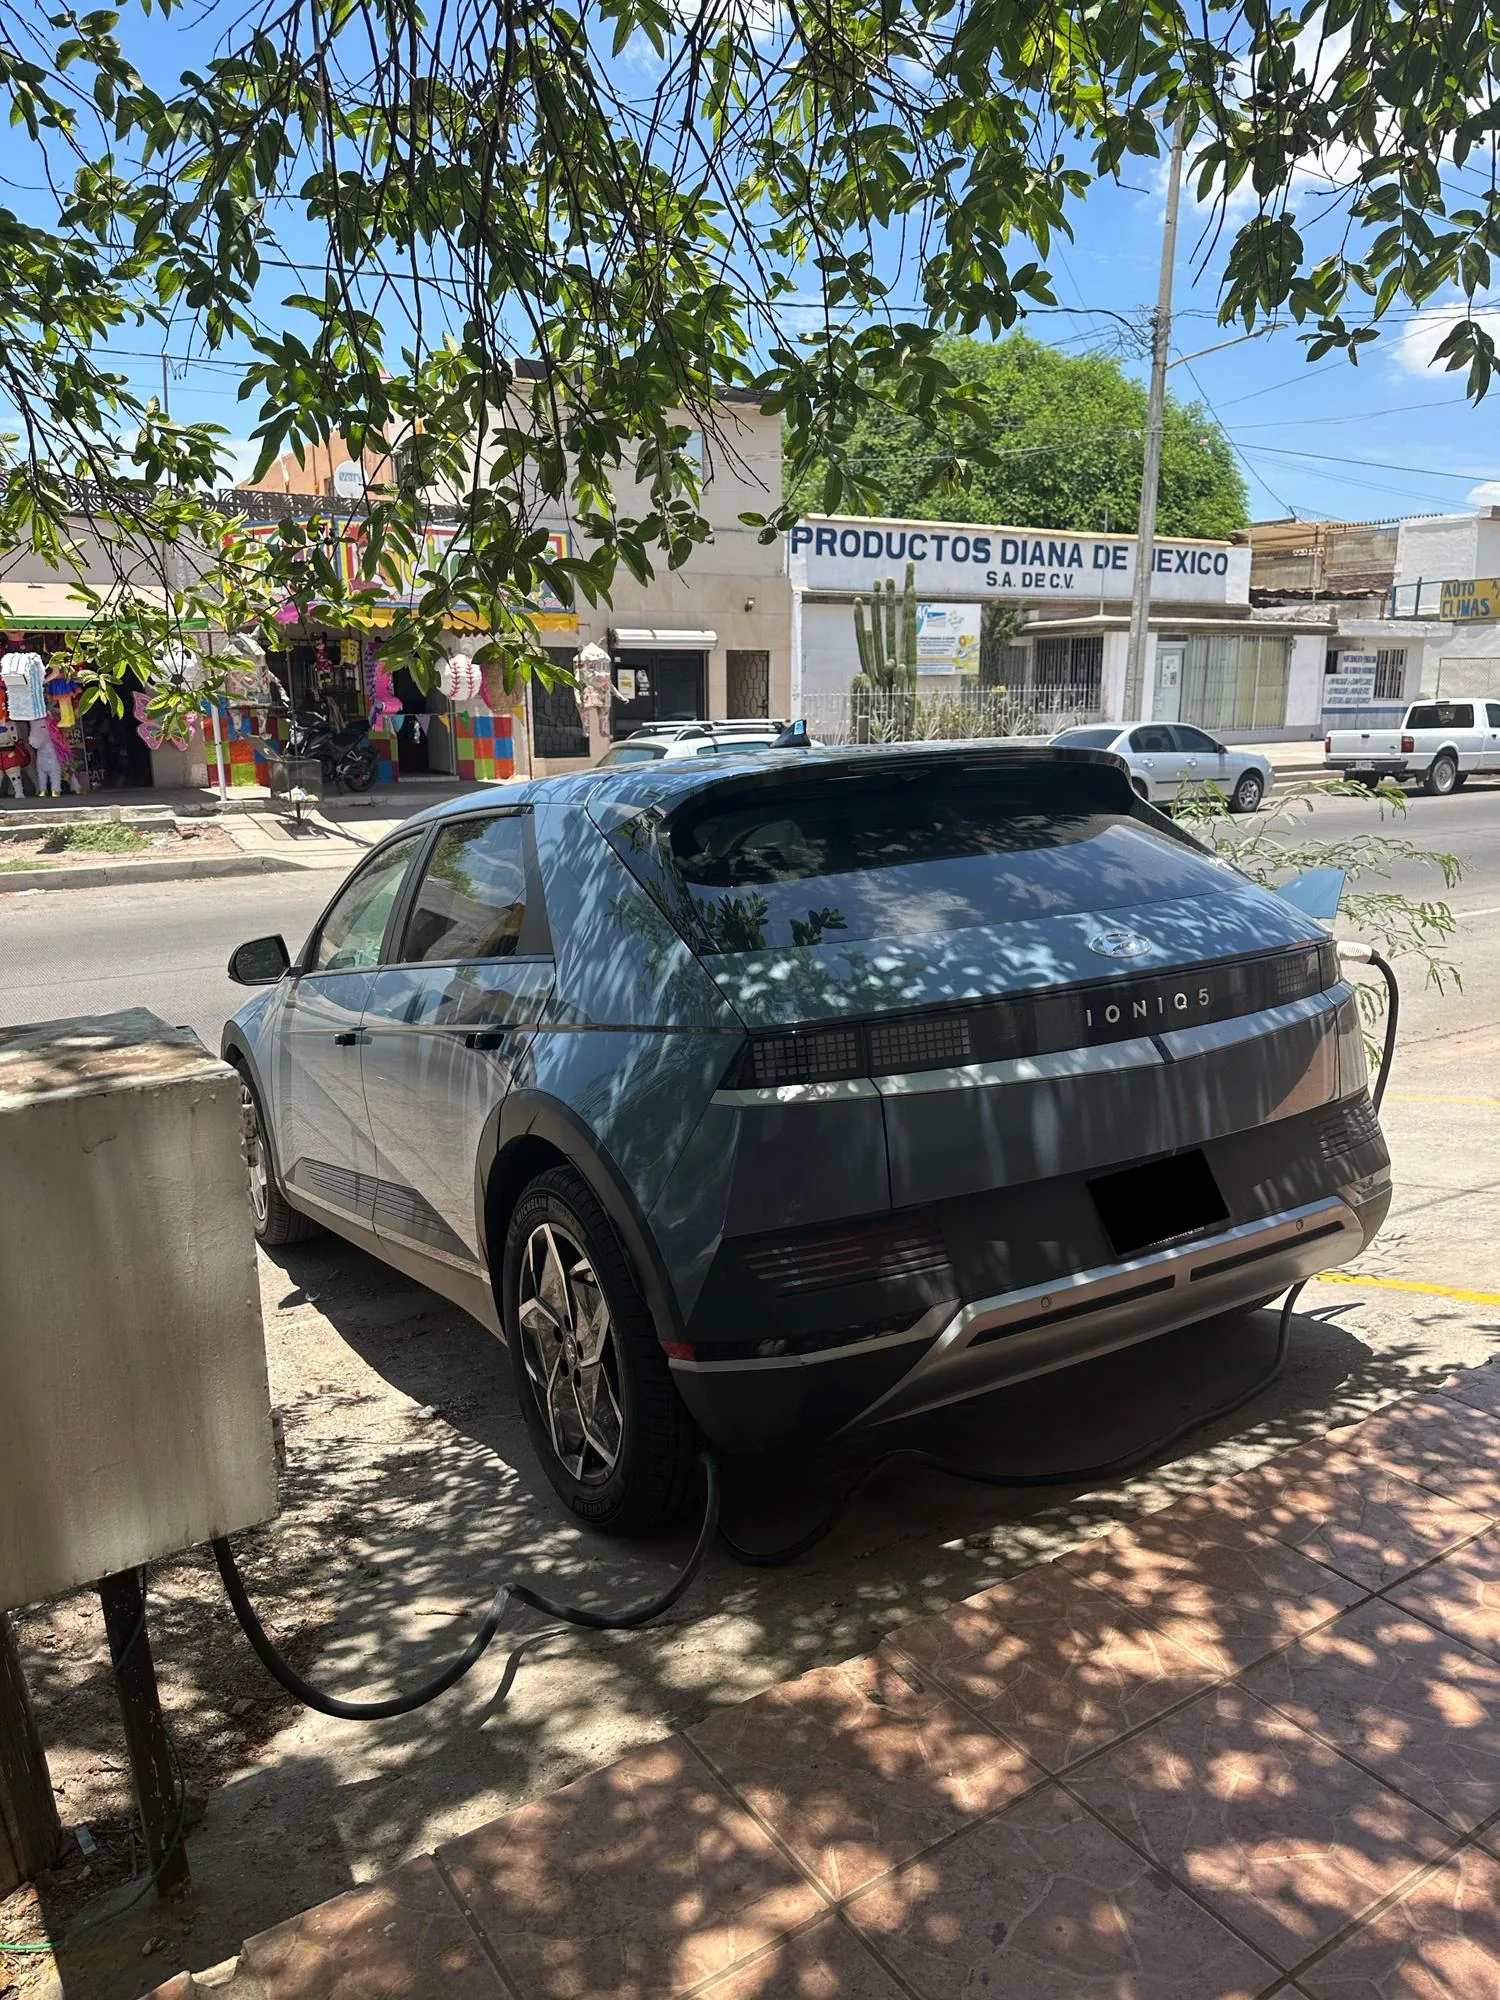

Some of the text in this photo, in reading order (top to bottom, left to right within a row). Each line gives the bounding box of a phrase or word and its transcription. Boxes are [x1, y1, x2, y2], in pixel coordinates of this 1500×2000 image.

[791, 526, 991, 564] PRODUCTOS
[1001, 539, 1083, 569] DIANA
[1093, 544, 1128, 570] DE
[986, 570, 1074, 589] S.A. DE C.V.
[1444, 580, 1475, 598] AUTO
[1442, 597, 1490, 618] CLIMAS
[1086, 992, 1188, 1027] IONIQ
[514, 1197, 548, 1226] MICHELIN
